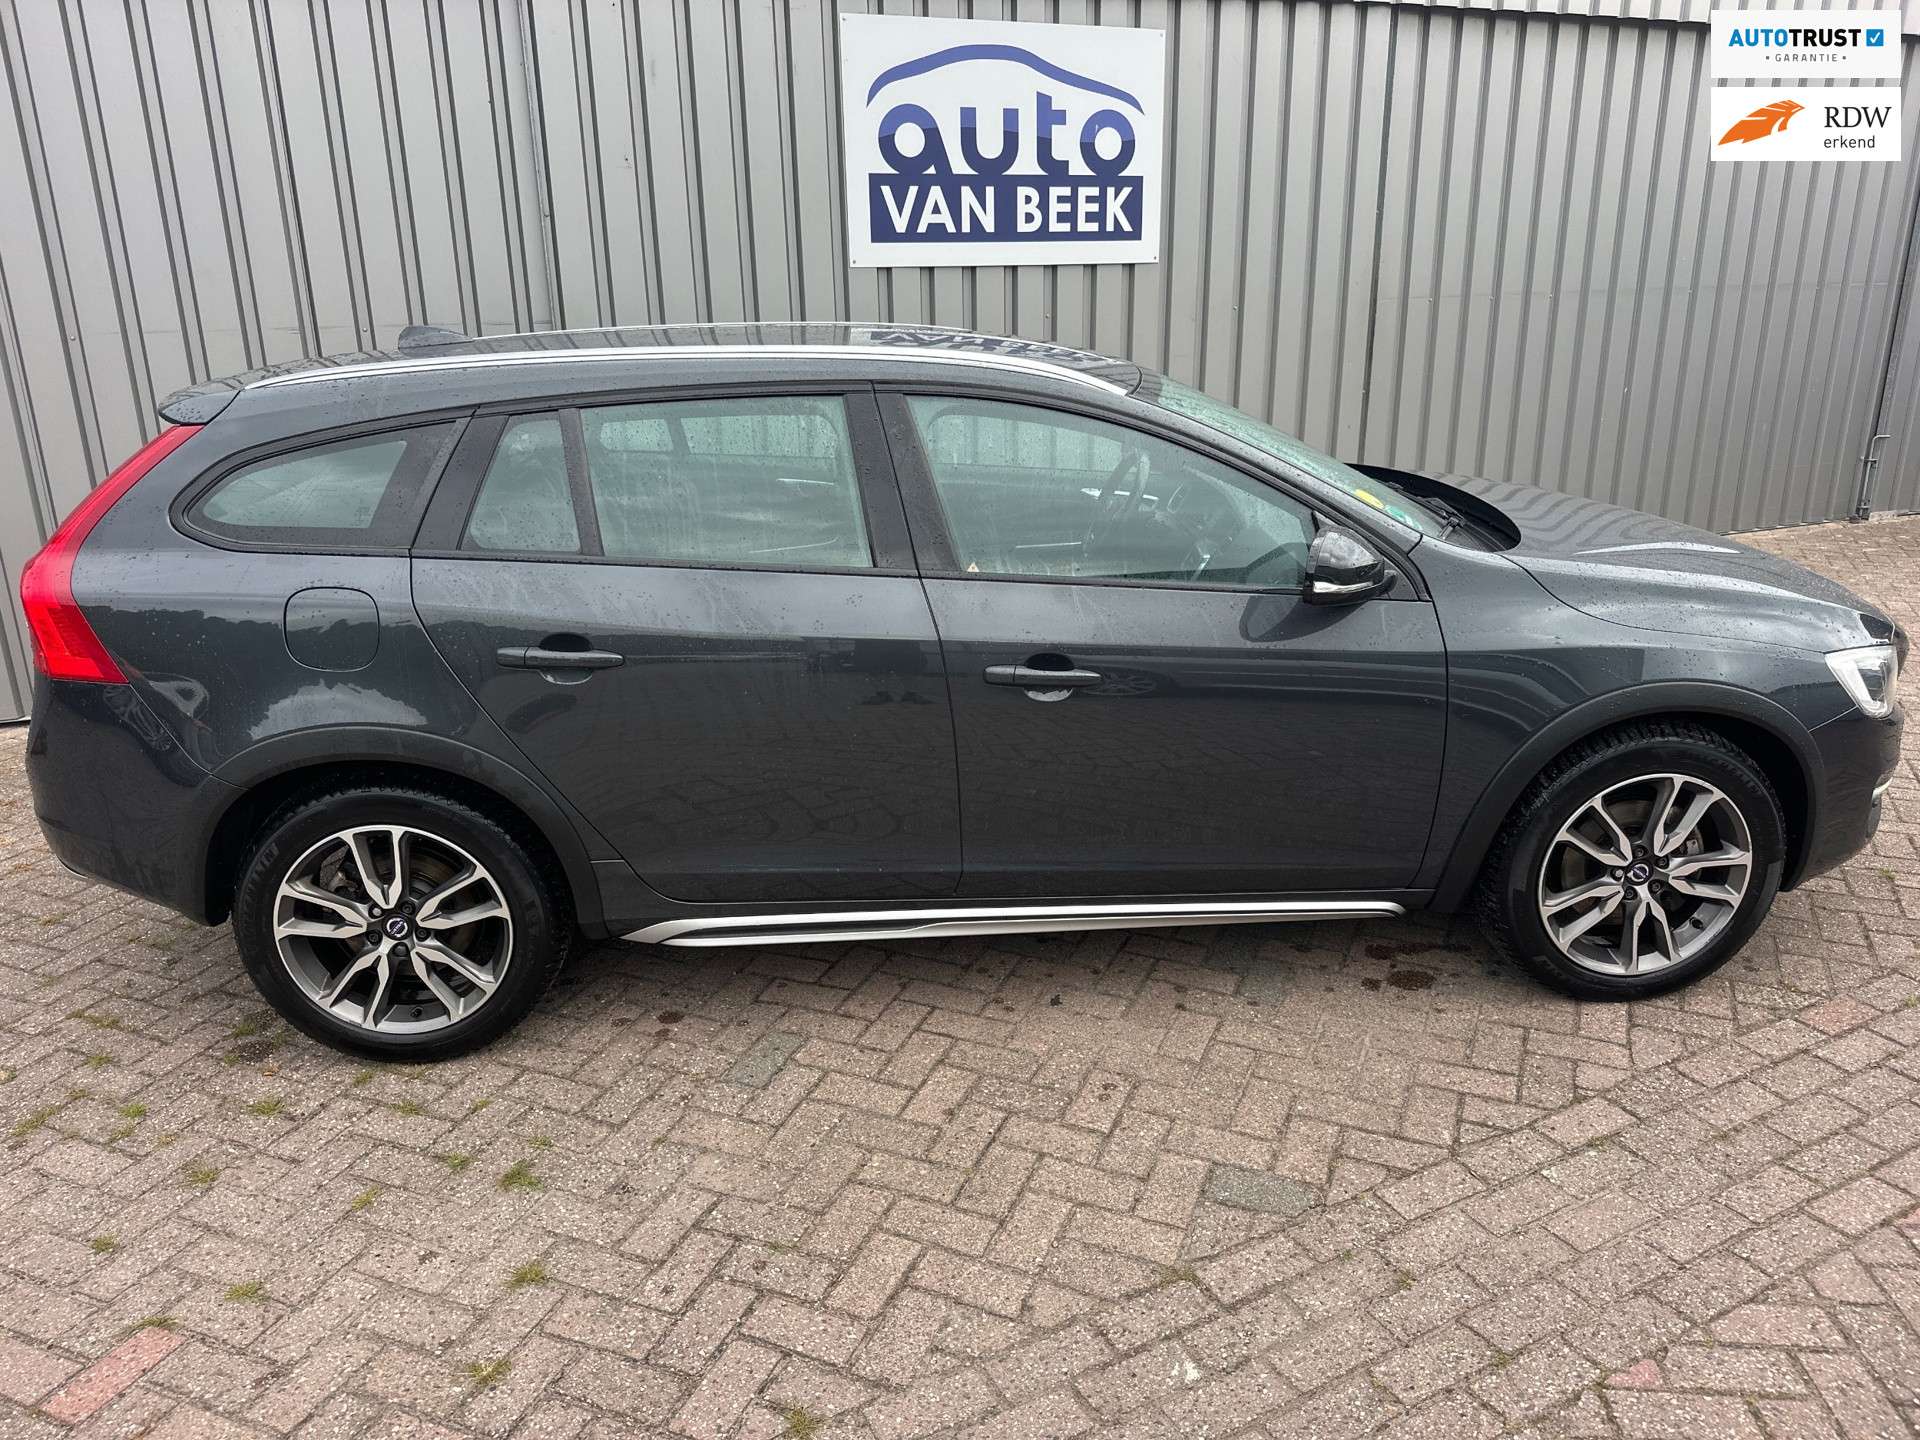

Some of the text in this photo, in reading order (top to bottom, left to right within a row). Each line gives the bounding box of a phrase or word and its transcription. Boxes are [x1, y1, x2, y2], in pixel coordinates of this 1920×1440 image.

[878, 91, 1136, 175] auto
[880, 185, 1134, 233] VAN BEEK
